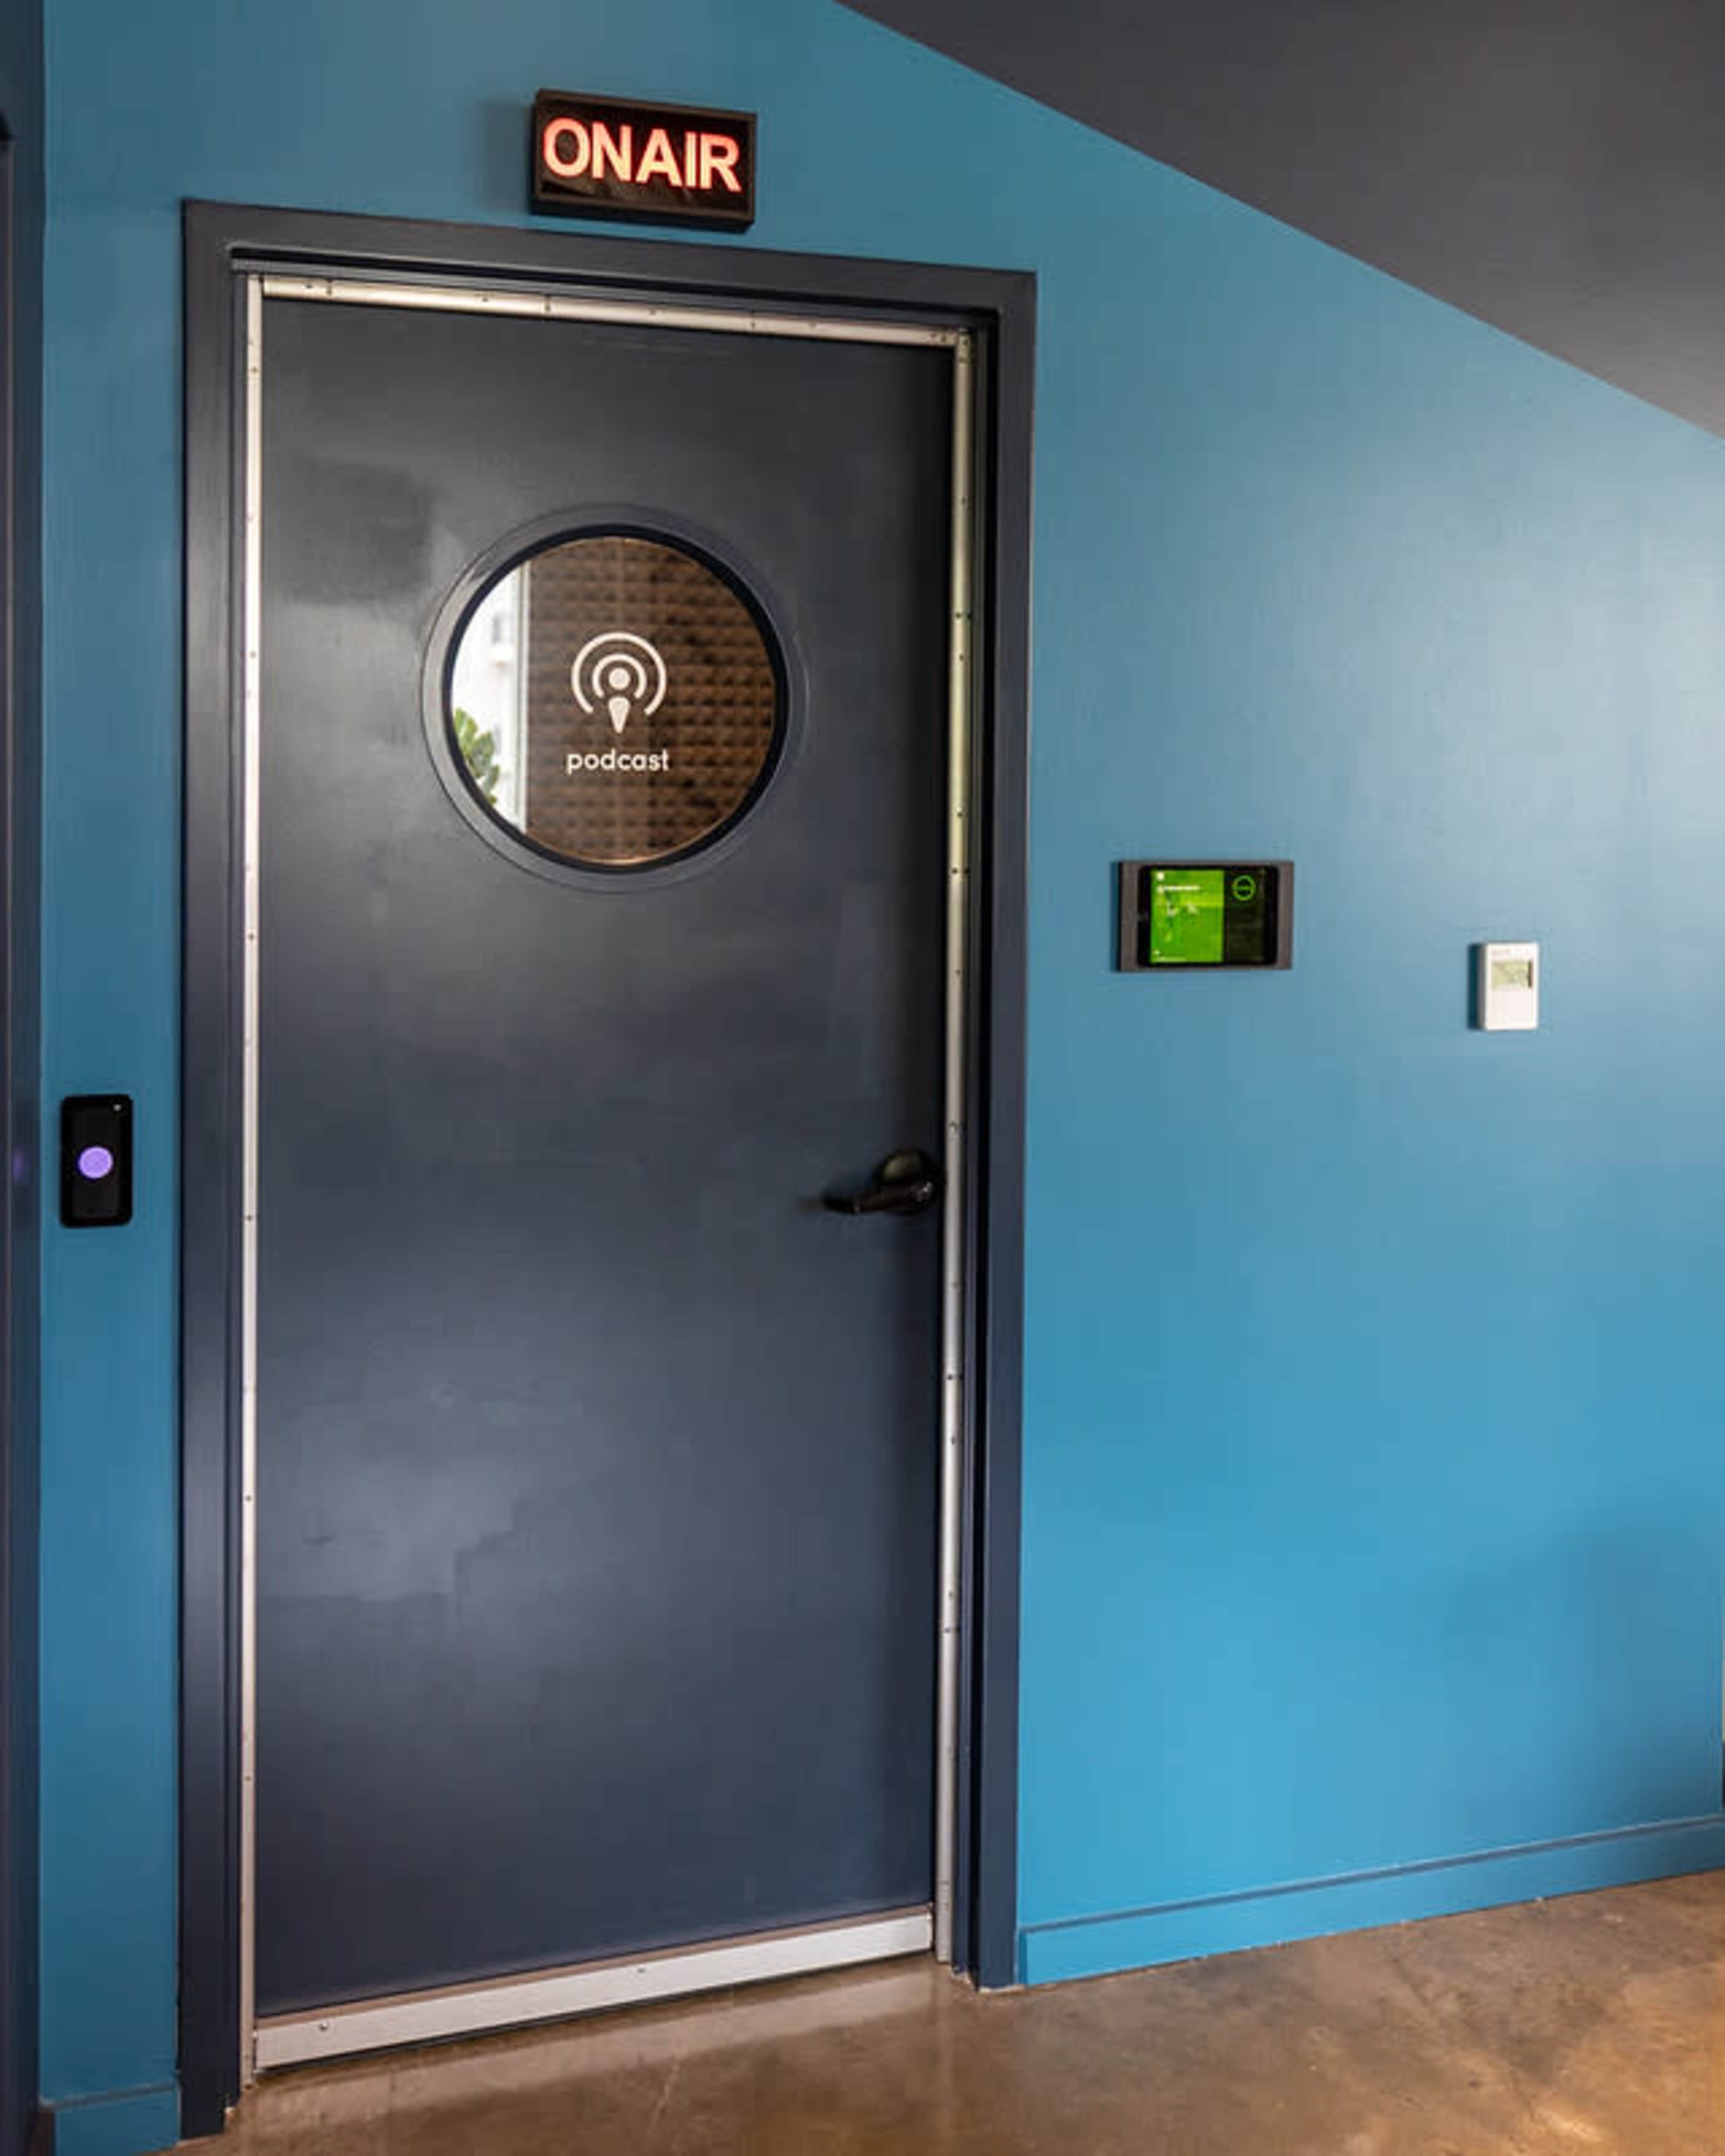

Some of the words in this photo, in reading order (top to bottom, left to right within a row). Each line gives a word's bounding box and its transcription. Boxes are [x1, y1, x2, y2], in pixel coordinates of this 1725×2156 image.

[543, 117, 632, 181] ON
[636, 129, 742, 192] AIR
[566, 748, 669, 776] podcast
